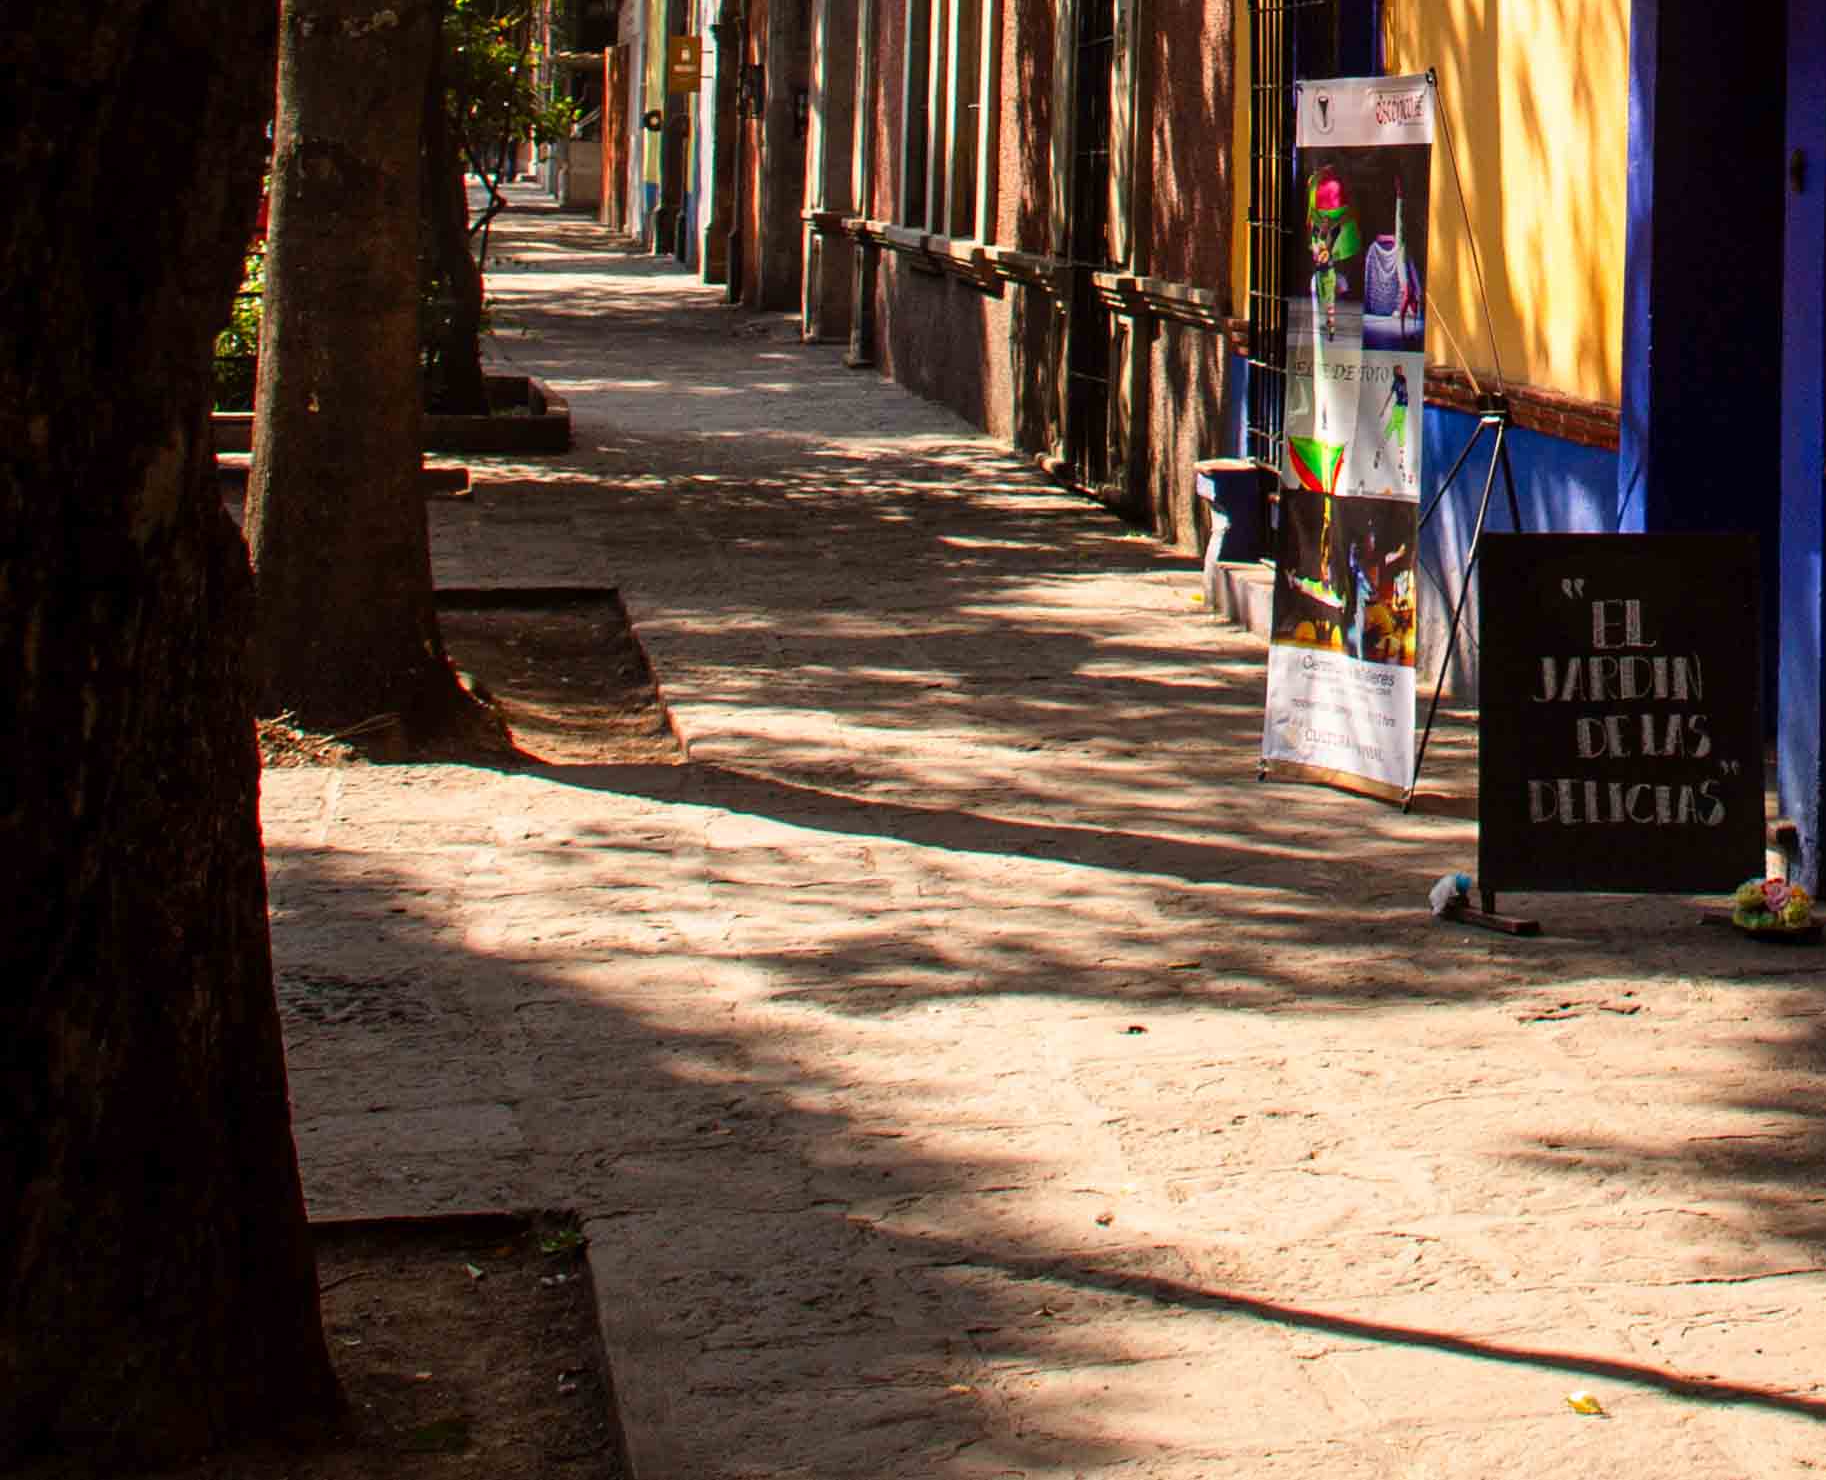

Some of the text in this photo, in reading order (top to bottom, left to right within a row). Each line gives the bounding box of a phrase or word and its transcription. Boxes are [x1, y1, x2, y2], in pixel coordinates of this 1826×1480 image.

[1533, 650, 1703, 703] JARDIN
[1577, 713, 1712, 759] DE LAS
